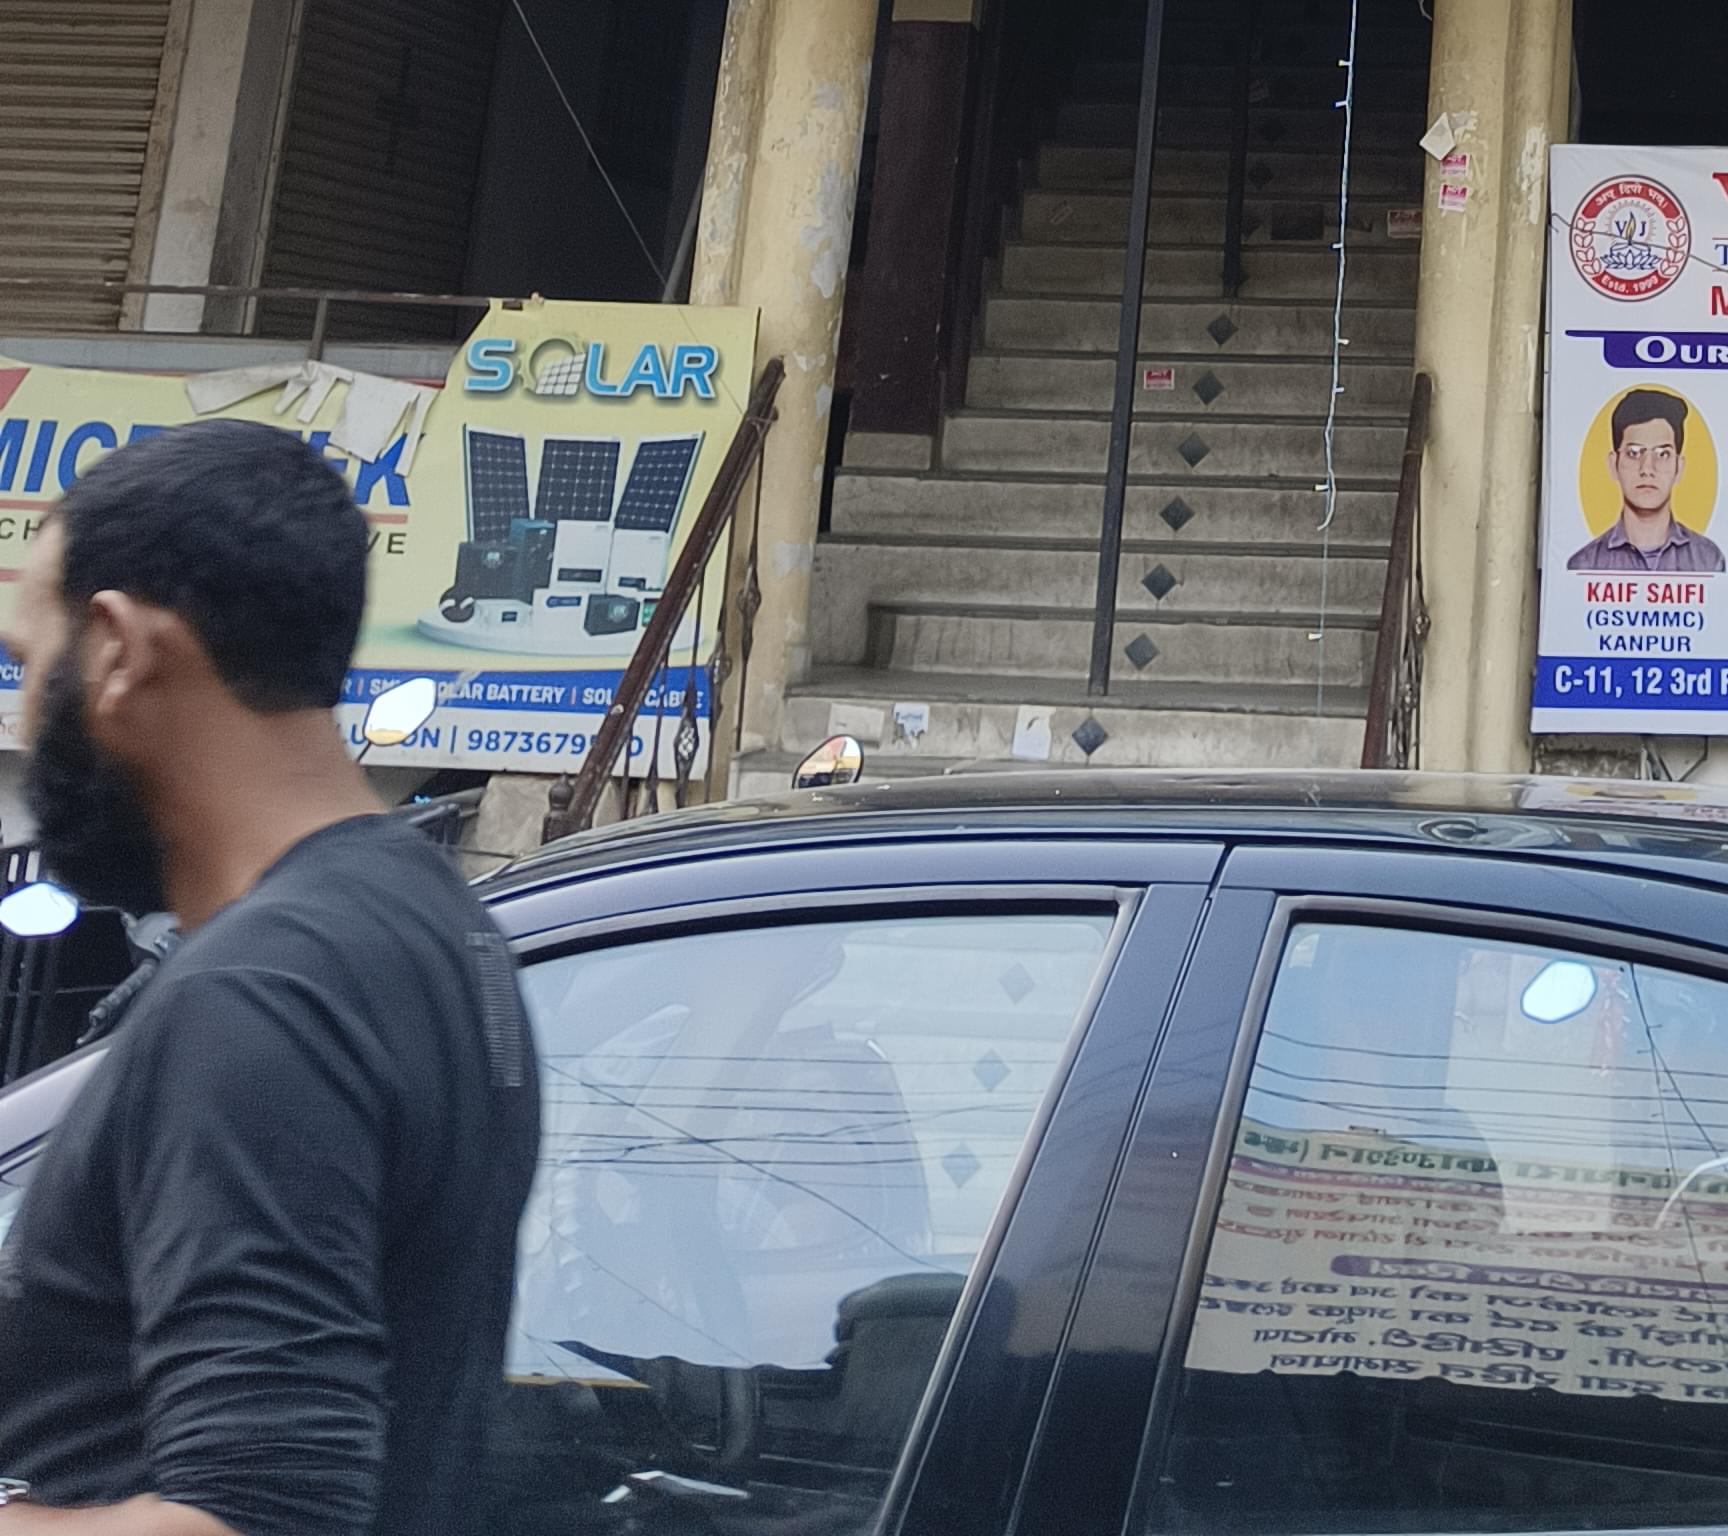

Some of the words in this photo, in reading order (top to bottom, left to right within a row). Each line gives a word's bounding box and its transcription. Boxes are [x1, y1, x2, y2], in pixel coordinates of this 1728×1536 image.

[1586, 582, 1638, 603] KAIF
[1646, 583, 1705, 605] SAIFI
[1586, 609, 1705, 630] (GSVMMC)
[1599, 634, 1691, 653] KANPUR
[1554, 666, 1623, 697] C-11,
[1631, 668, 1662, 695] 12
[1669, 668, 1713, 695] 3rd
[486, 684, 566, 705] BATTERY
